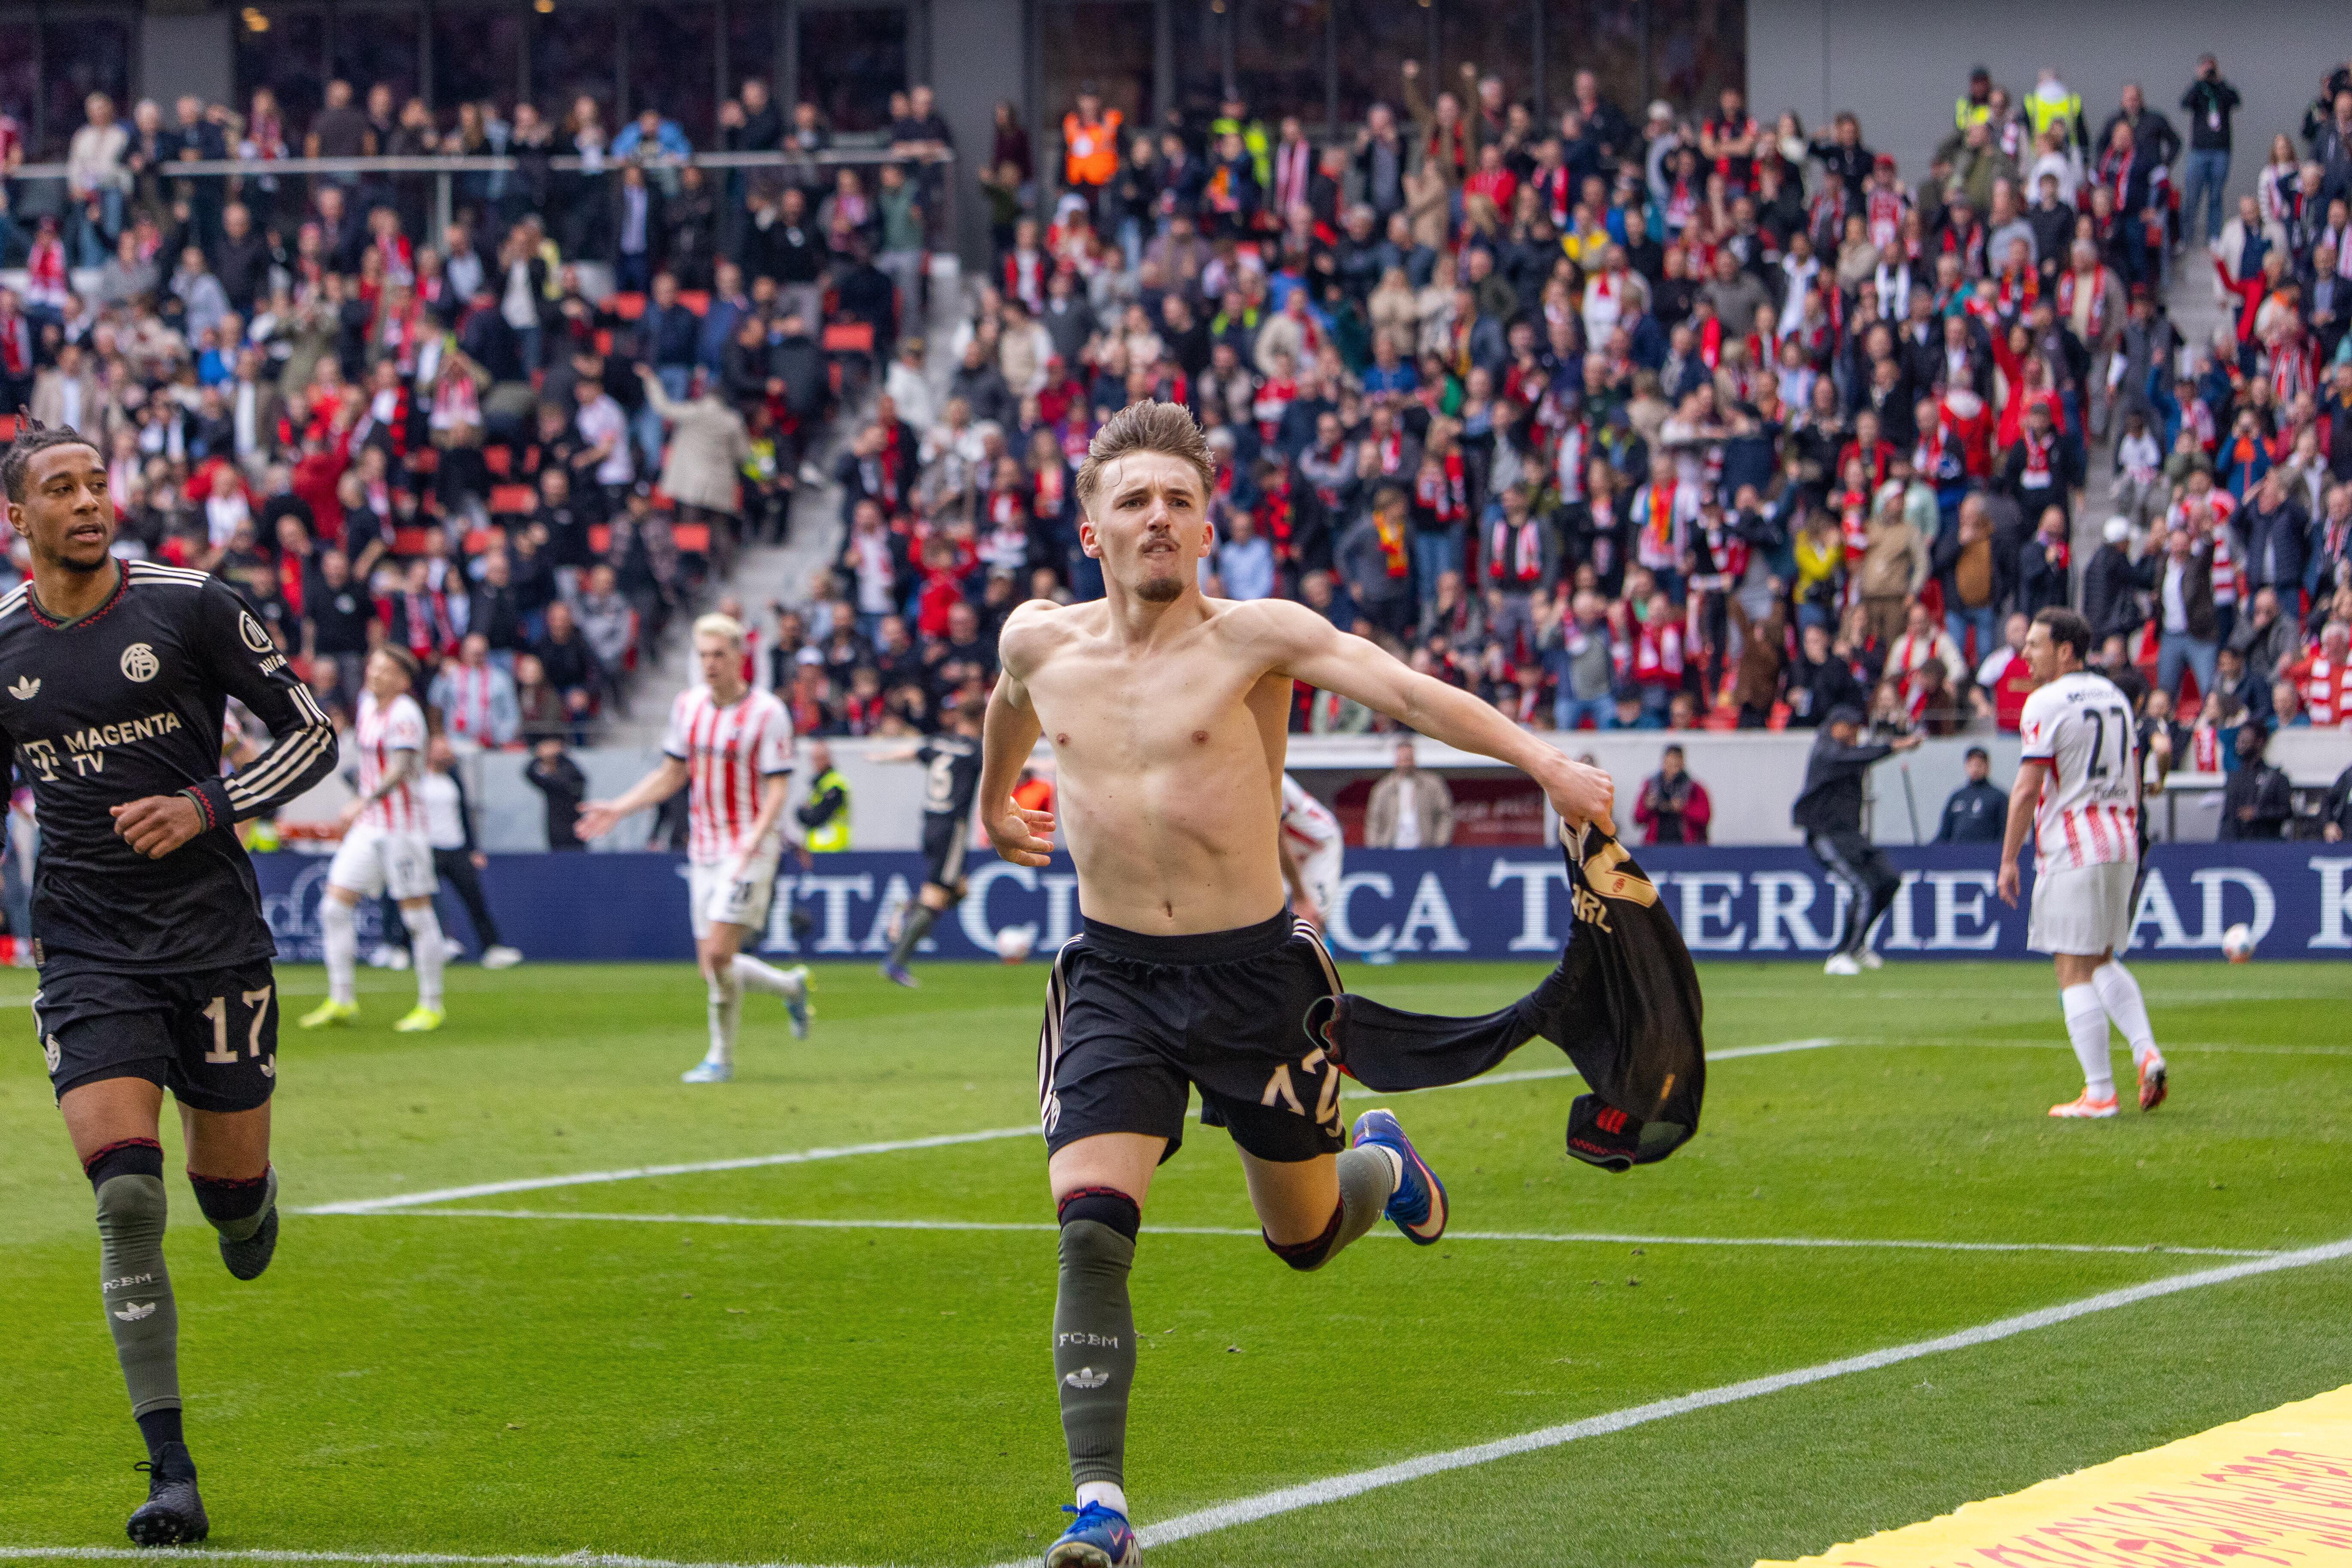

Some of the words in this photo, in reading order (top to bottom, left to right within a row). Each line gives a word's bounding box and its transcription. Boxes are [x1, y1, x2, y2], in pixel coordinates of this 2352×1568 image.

[62, 712, 182, 753] MAGENTA
[72, 751, 103, 777] TV
[676, 864, 938, 952] ITA
[2127, 866, 2276, 949] AD
[202, 985, 272, 1063] 17
[1059, 1332, 1118, 1349] FCBM
